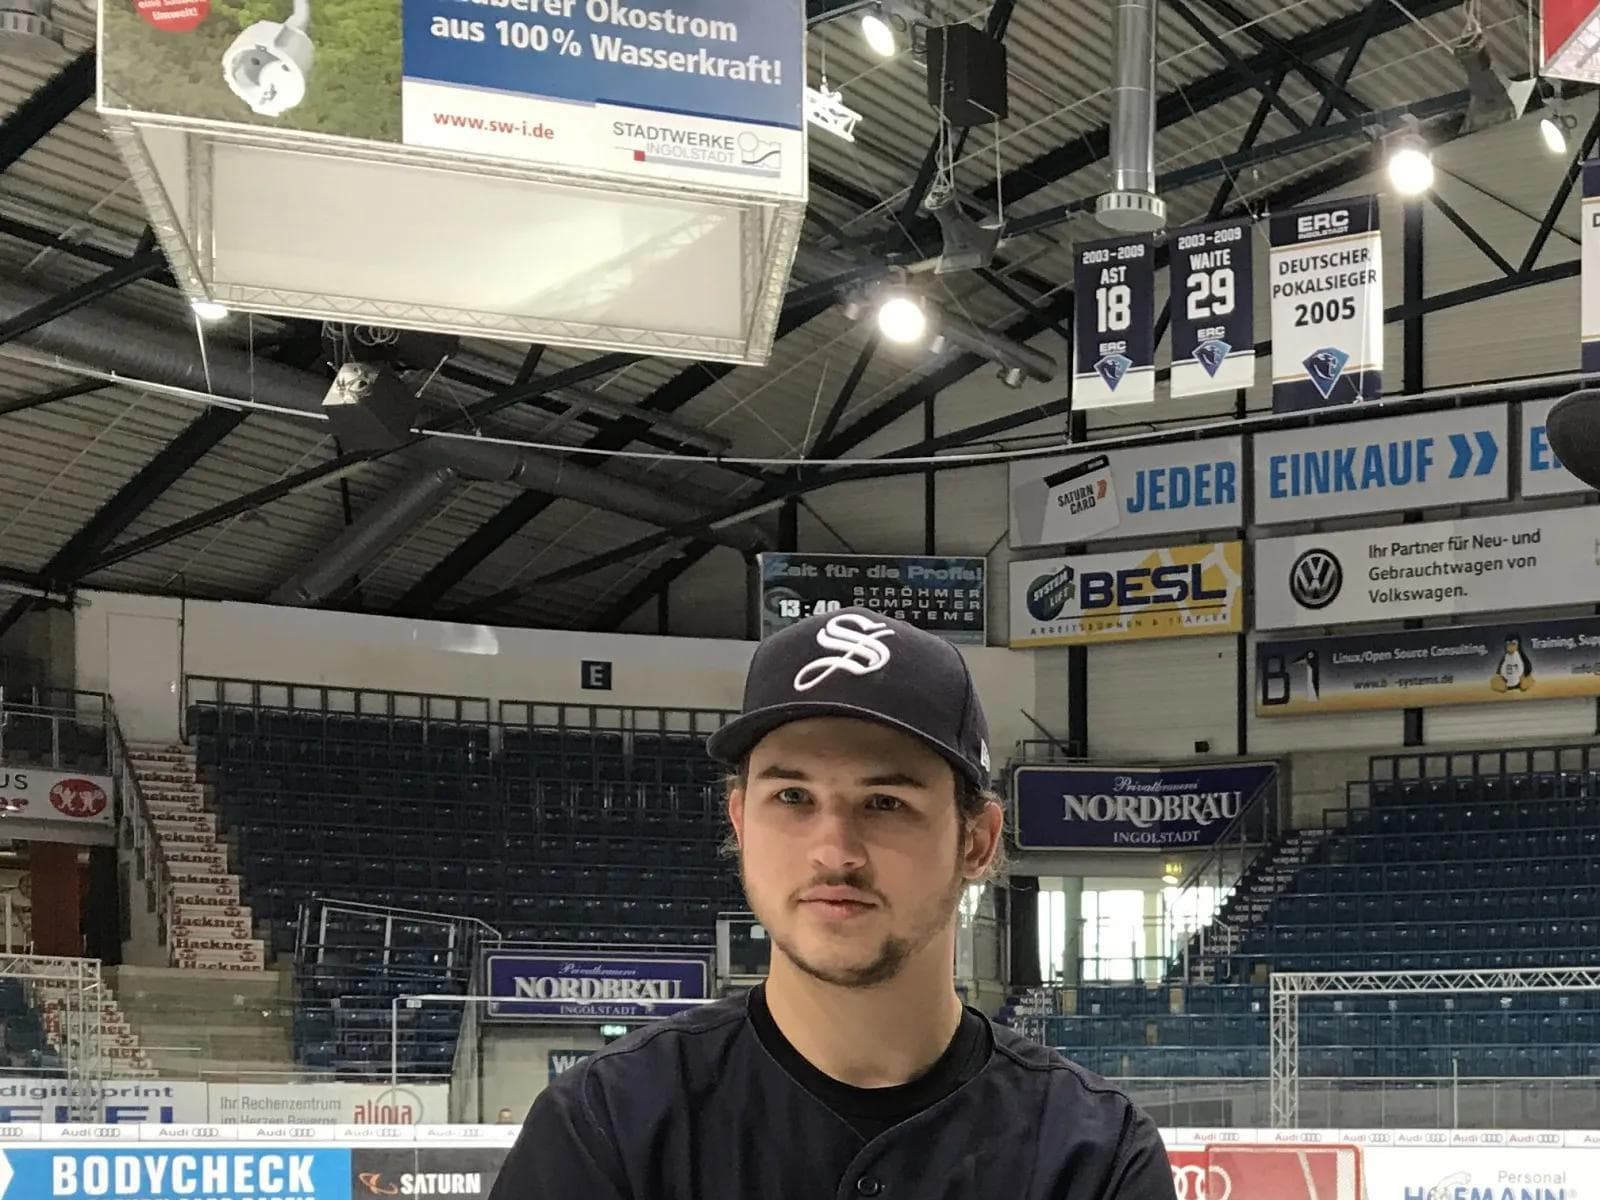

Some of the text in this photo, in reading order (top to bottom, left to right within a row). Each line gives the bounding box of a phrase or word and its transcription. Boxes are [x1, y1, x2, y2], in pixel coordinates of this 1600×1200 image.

[430, 16, 486, 42] aus
[591, 33, 782, 85] Wasserkraft!
[434, 112, 555, 140] www.sw-i.de
[613, 121, 735, 151] STADTWERKE
[646, 142, 735, 165] INGOLSTADT
[1297, 209, 1349, 233] ERC
[1178, 226, 1242, 250] 2003-2009
[1082, 243, 1145, 265] 2003-2009
[1190, 249, 1231, 271] WAITE
[1279, 248, 1372, 277] DEUTSCHER
[1100, 266, 1127, 286] AST
[1273, 269, 1378, 299] POKALSIEGER
[1186, 268, 1236, 320] 29
[1096, 285, 1132, 333] 18
[1295, 296, 1356, 328] 2005
[1197, 326, 1226, 339] ERC
[1100, 341, 1126, 353] ERC
[1530, 426, 1564, 472] E
[1269, 438, 1434, 499] EINKAUF
[1057, 484, 1095, 508] SATURN
[1126, 461, 1237, 515] JEDER
[1070, 496, 1097, 515] CARD
[1368, 528, 1541, 559] Ihr Partner für Neu- und
[770, 561, 818, 577] Zeit
[825, 562, 860, 577] für
[867, 564, 900, 580] die
[1369, 554, 1537, 584] Gebrauchtwagen von
[853, 585, 981, 599] STRÖHMER
[1080, 563, 1227, 610] BESL
[1369, 583, 1468, 604] Volkswagen.
[853, 598, 981, 611] COMPUTER
[876, 610, 976, 622] YSTEME
[1394, 647, 1429, 660] Source
[590, 665, 604, 687] E
[1062, 791, 1242, 828] NORDBRÄU
[1113, 830, 1200, 844] INGOLSTADT
[560, 1005, 637, 1016] INGOLSTADT
[220, 1096, 341, 1110] Ihr Rechenzentrum
[61, 1128, 91, 1137] Audi
[159, 1128, 188, 1137] Audi
[257, 1128, 286, 1137] Audi
[1509, 1134, 1535, 1143] Audi
[52, 1154, 315, 1196] BODYCHECK
[400, 1172, 481, 1195] SATURN
[1498, 1169, 1567, 1184] Personal
